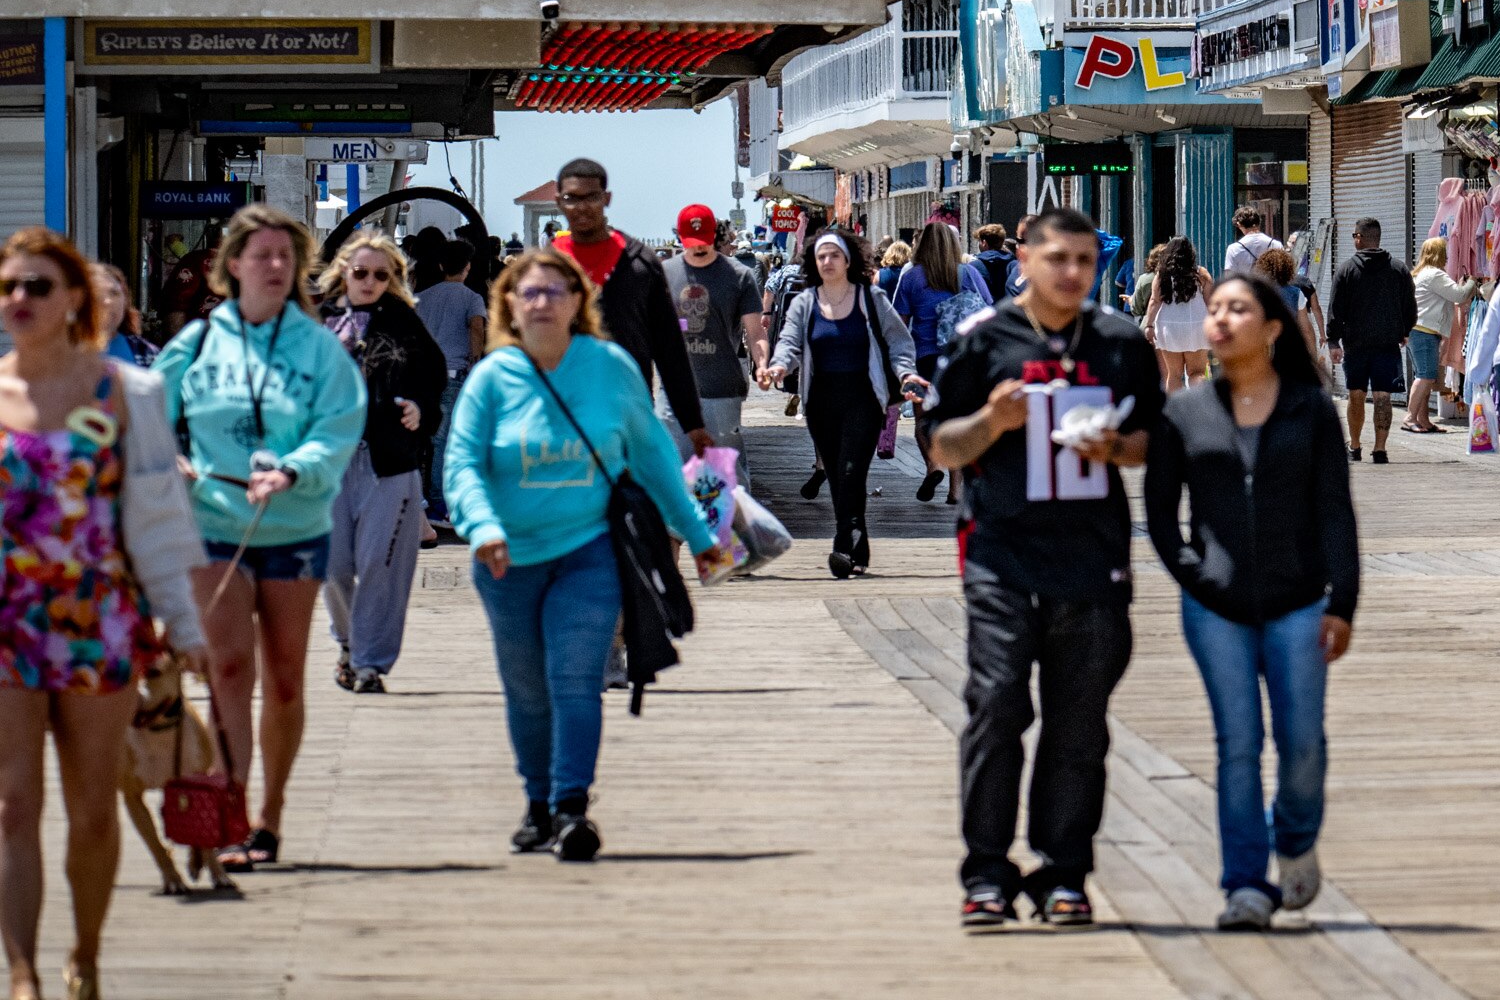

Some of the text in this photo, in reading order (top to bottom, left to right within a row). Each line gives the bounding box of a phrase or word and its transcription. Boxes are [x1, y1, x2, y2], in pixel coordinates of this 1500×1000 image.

[100, 32, 349, 51] RIPLEY'S Believe It or Not!
[332, 143, 377, 160] MEN
[155, 192, 231, 204] ROYAL BANK
[777, 209, 795, 218] COOL
[774, 219, 798, 229] TOPICS
